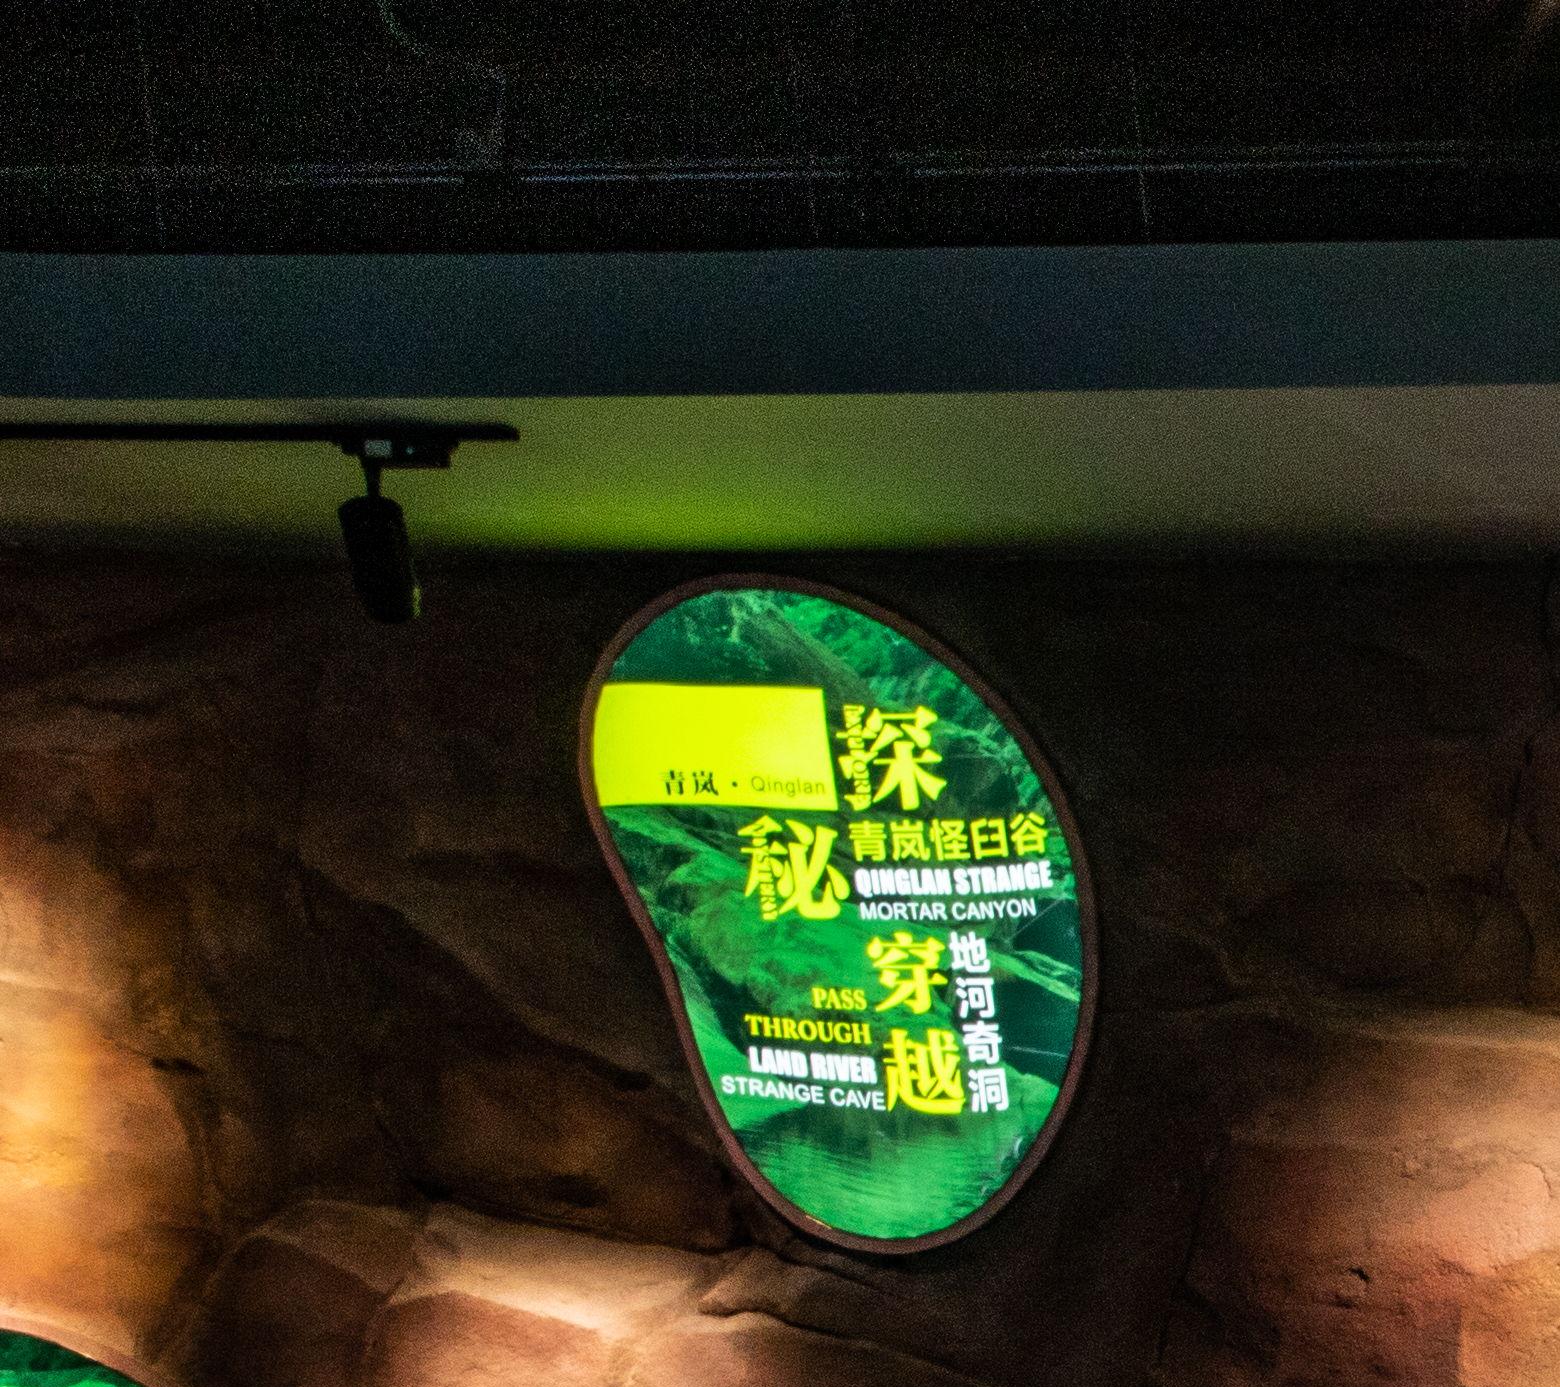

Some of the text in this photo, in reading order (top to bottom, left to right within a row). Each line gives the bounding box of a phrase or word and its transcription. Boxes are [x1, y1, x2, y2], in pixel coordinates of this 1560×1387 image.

[661, 770, 825, 797] 青岚 Qinglan
[849, 811, 1049, 861] 青岚怪臼谷
[854, 862, 1054, 897] QINGLAN STRANGE
[859, 897, 1037, 921] MORTAR CANYON
[812, 987, 866, 1012] PASS
[745, 1014, 872, 1046] THROUGH
[867, 932, 965, 1115] 穿越
[949, 931, 1009, 1114] 地河奇洞
[748, 1046, 878, 1085] LAND RIVER
[721, 1074, 886, 1111] STRANGE CAVE
